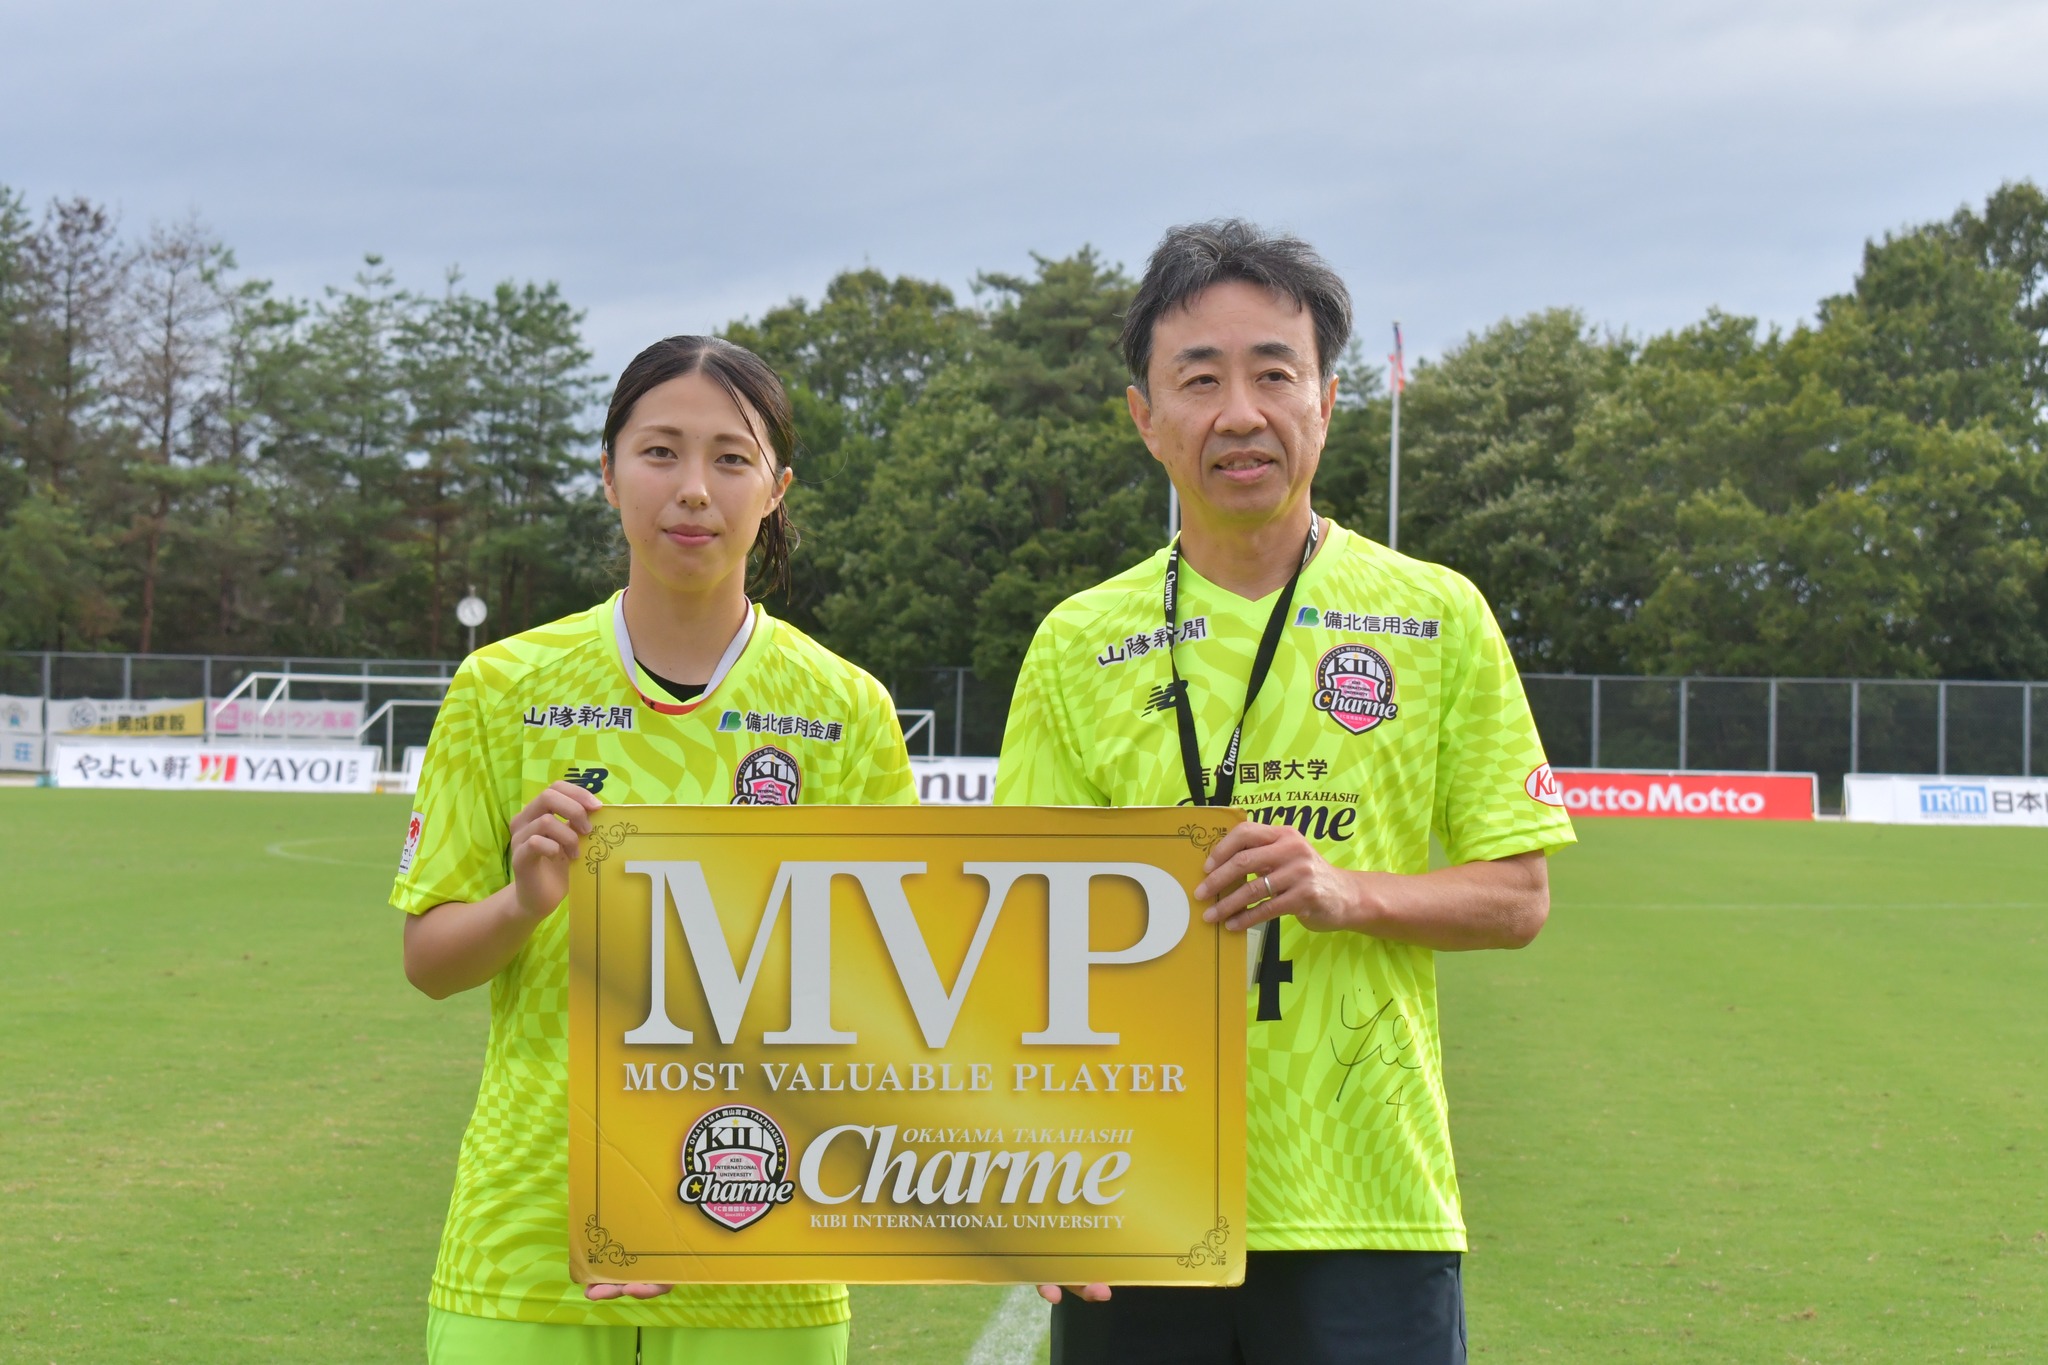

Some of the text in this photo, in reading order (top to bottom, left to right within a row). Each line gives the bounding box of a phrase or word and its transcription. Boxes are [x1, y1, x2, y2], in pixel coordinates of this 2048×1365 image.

[1165, 570, 1176, 611] Charme
[1323, 610, 1439, 639] 備北信用金庫
[523, 706, 632, 729] 山陽新聞
[1314, 690, 1397, 719] Charme
[745, 711, 843, 741] 備北信用金庫
[1222, 727, 1240, 776] Charme
[74, 754, 191, 780] やよい軒
[245, 757, 343, 783] YAYOI
[1232, 791, 1360, 805] KAYAMA TAKAHASHI
[1647, 783, 1765, 813] Motto
[1993, 790, 2048, 813] 日本
[624, 860, 1191, 1048] MVP
[623, 1063, 1187, 1092] MOST VALUABLE PLAYER
[1386, 1084, 1407, 1122] 4
[689, 1113, 721, 1145] OKAYAMA
[750, 1112, 783, 1146] TAKAHASHI
[902, 1128, 1135, 1144] OKAYAMA TAKAHASHI
[799, 1124, 1131, 1205] Charme
[679, 1174, 794, 1202] Charme
[810, 1215, 1125, 1229] KIBI INTERNATIONAL UNIVERSITY
